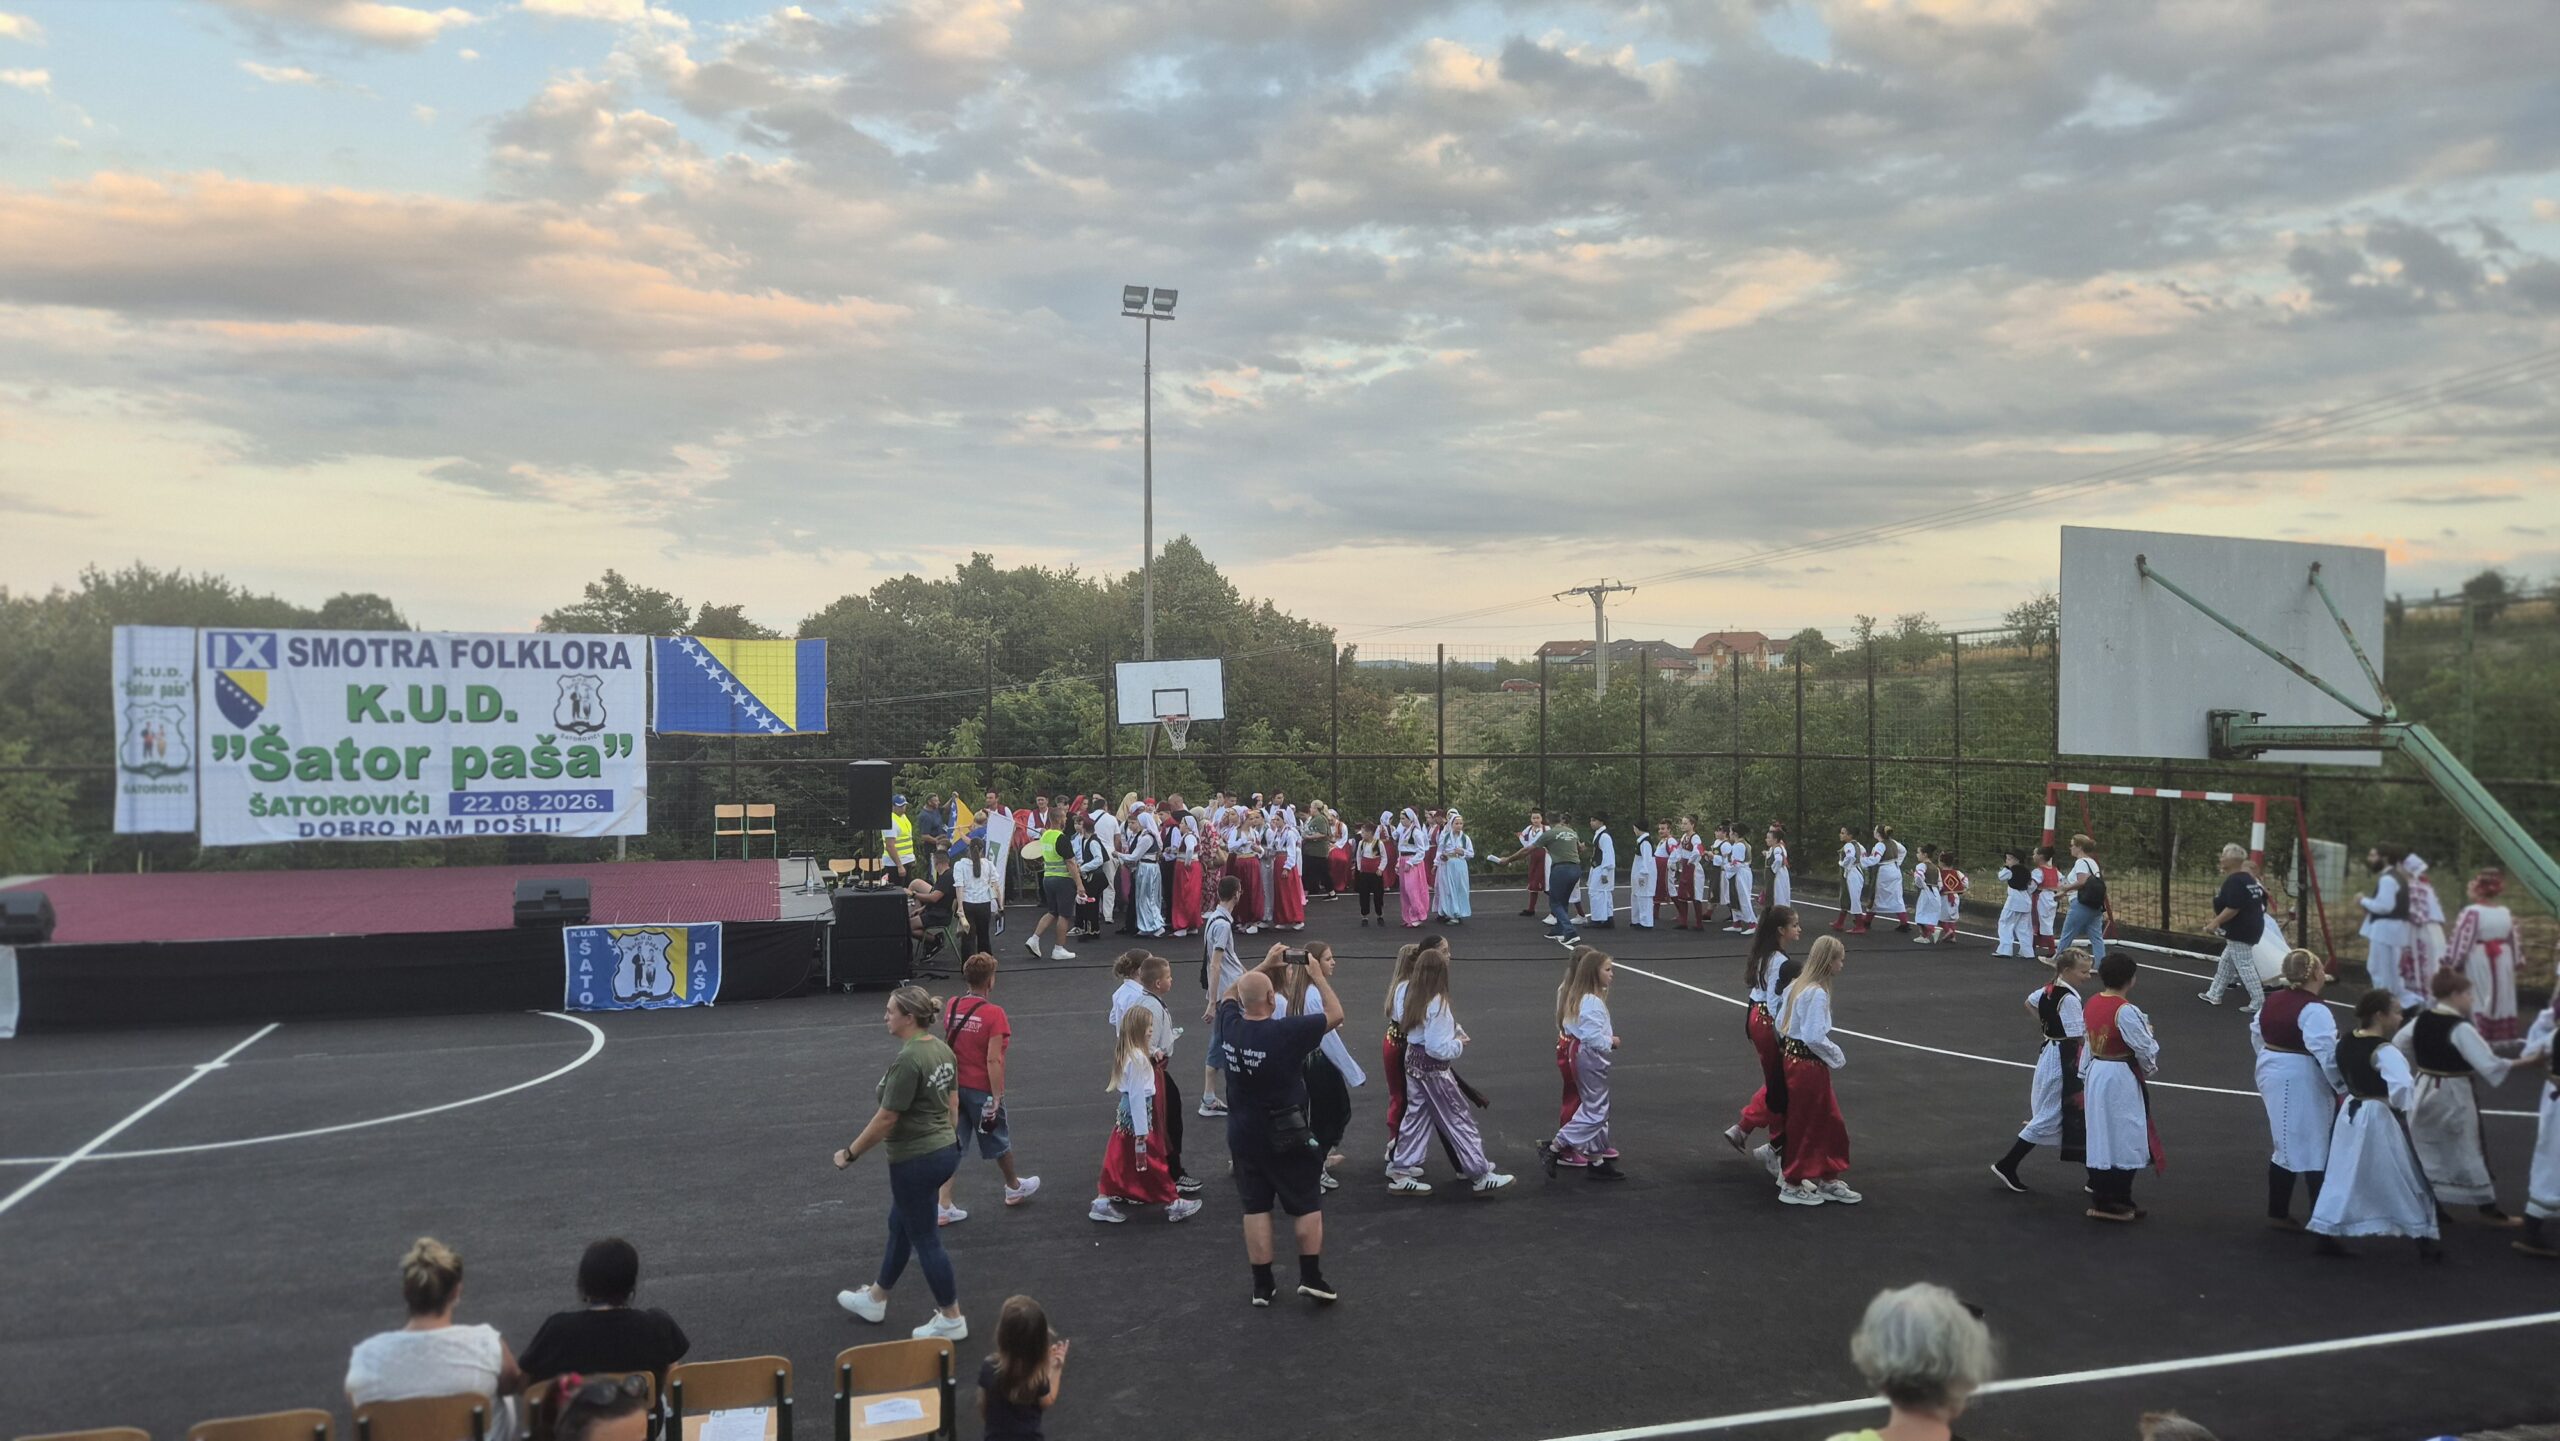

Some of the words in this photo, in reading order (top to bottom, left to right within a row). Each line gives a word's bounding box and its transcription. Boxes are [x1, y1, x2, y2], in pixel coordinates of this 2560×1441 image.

[214, 634, 271, 668] IX
[288, 637, 439, 669] SMOTRA
[451, 639, 632, 670] FOLKLORA
[133, 667, 183, 677] K.U.D.
[347, 684, 518, 723] K.U.D.
[249, 790, 430, 817] ŠATOROVIĆI
[462, 793, 605, 813] 22.08.2026.
[299, 821, 395, 838] DOBRO
[405, 819, 464, 836] NAM
[474, 815, 562, 834] DOŠLI!
[579, 938, 595, 1009] ŠATO
